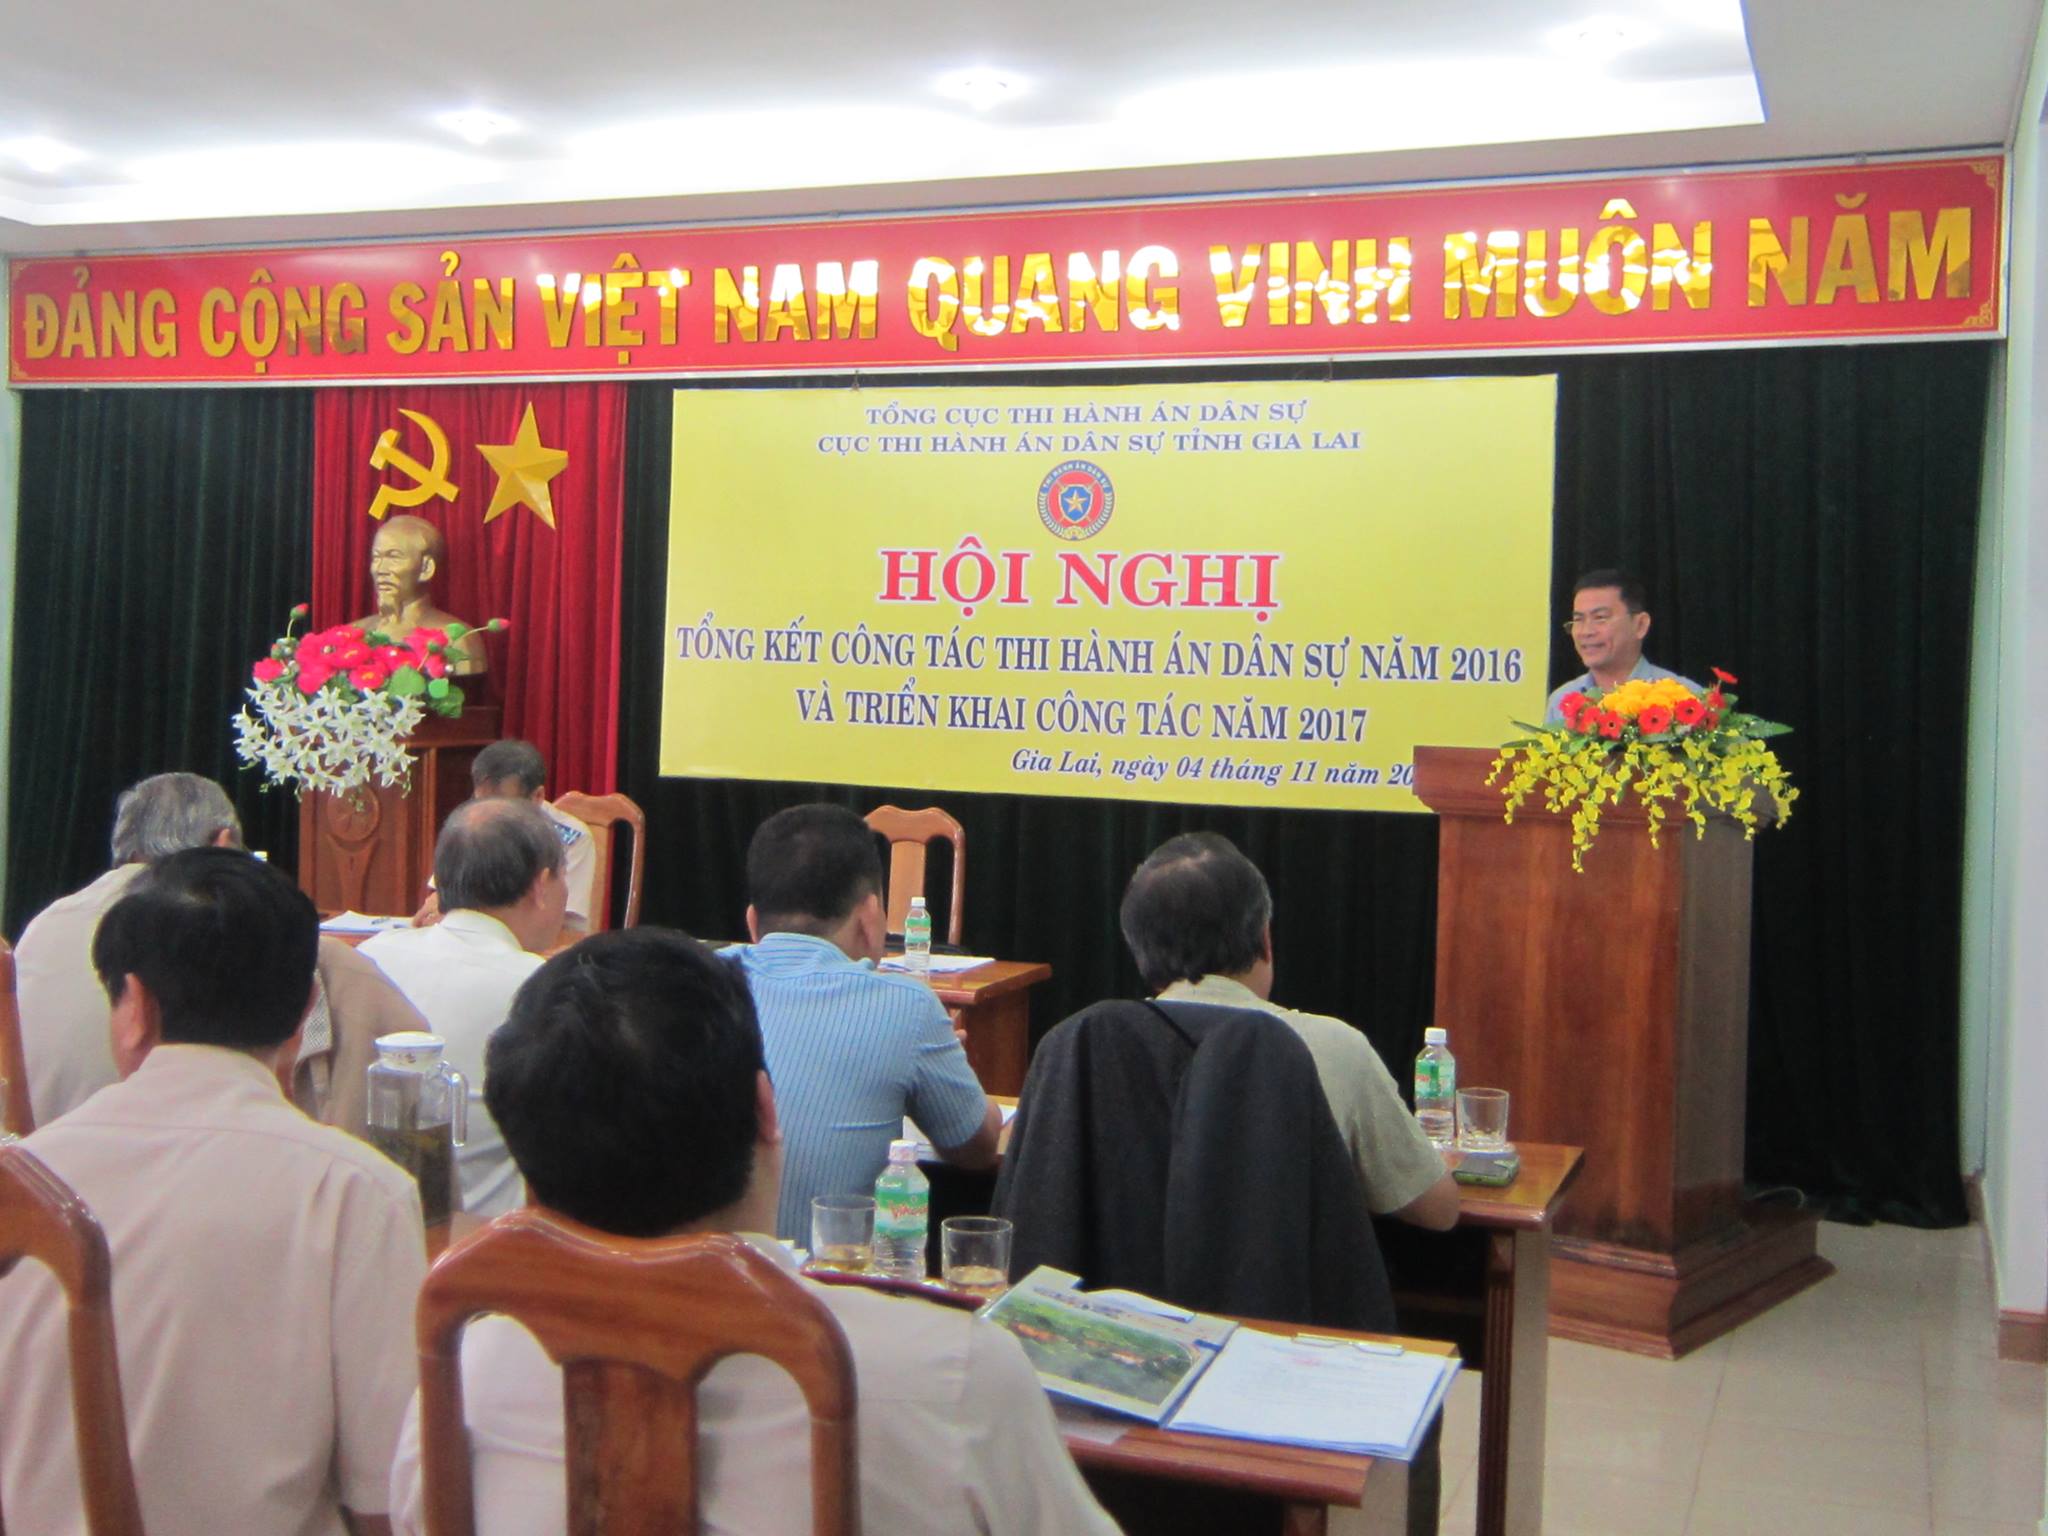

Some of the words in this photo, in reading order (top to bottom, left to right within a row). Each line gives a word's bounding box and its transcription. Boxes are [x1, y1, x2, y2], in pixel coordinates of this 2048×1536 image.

[24, 265, 177, 360] ĐẢNG
[199, 268, 367, 373] CỘNG
[386, 250, 515, 353] SẢN
[536, 253, 690, 365] VIỆT
[714, 259, 878, 344] NAM
[907, 245, 1180, 352] QUANG
[1208, 235, 1412, 328] VINH
[1444, 198, 1712, 319] MUÔN
[1748, 192, 1972, 307] NĂM
[818, 436, 870, 456] CỤC
[879, 436, 922, 453] THI
[929, 430, 1007, 453] HÀNH
[1015, 429, 1053, 453] ÁN
[1062, 430, 1120, 452] DÂN
[1128, 430, 1165, 455] SỰ
[1173, 425, 1242, 451] TỈNH
[1252, 432, 1303, 451] GIA
[1313, 431, 1361, 450] LAI
[866, 403, 936, 425] TỔNG
[944, 407, 999, 427] CỤC
[1008, 407, 1053, 425] THI
[1062, 402, 1140, 424] HÀNH
[1151, 400, 1190, 423] ÁN
[1199, 401, 1259, 422] DÂN
[1269, 400, 1308, 425] SỰ
[879, 536, 1031, 617] HỘI
[1056, 553, 1280, 622] NGHỊ
[677, 611, 754, 660] TỔNG
[763, 615, 822, 663] KẾT
[831, 623, 916, 667] CÔNG
[925, 625, 985, 669] TÁC
[995, 637, 1050, 671] THI
[1060, 629, 1153, 674] HÀNH
[1163, 631, 1211, 677] ÁN
[1222, 632, 1294, 679] DÂN
[1304, 636, 1350, 687] SỰ
[1360, 636, 1439, 681] NĂM
[1451, 648, 1522, 683] 2016
[796, 680, 834, 722] VÀ
[845, 676, 938, 728] TRIỂN
[947, 695, 1026, 731] KHAI
[1036, 690, 1127, 736] CÔNG
[1136, 692, 1201, 738] TÁC
[1211, 697, 1288, 740] NĂM
[1299, 709, 1367, 743] 2017
[1012, 748, 1052, 773] Gia
[1059, 750, 1102, 779] Lai,
[1111, 755, 1169, 782] ngày
[1176, 756, 1204, 779] 04
[1209, 758, 1283, 787] tháng
[1288, 760, 1316, 783] 11
[1324, 761, 1379, 786] năm
[1386, 763, 1413, 787] 20
